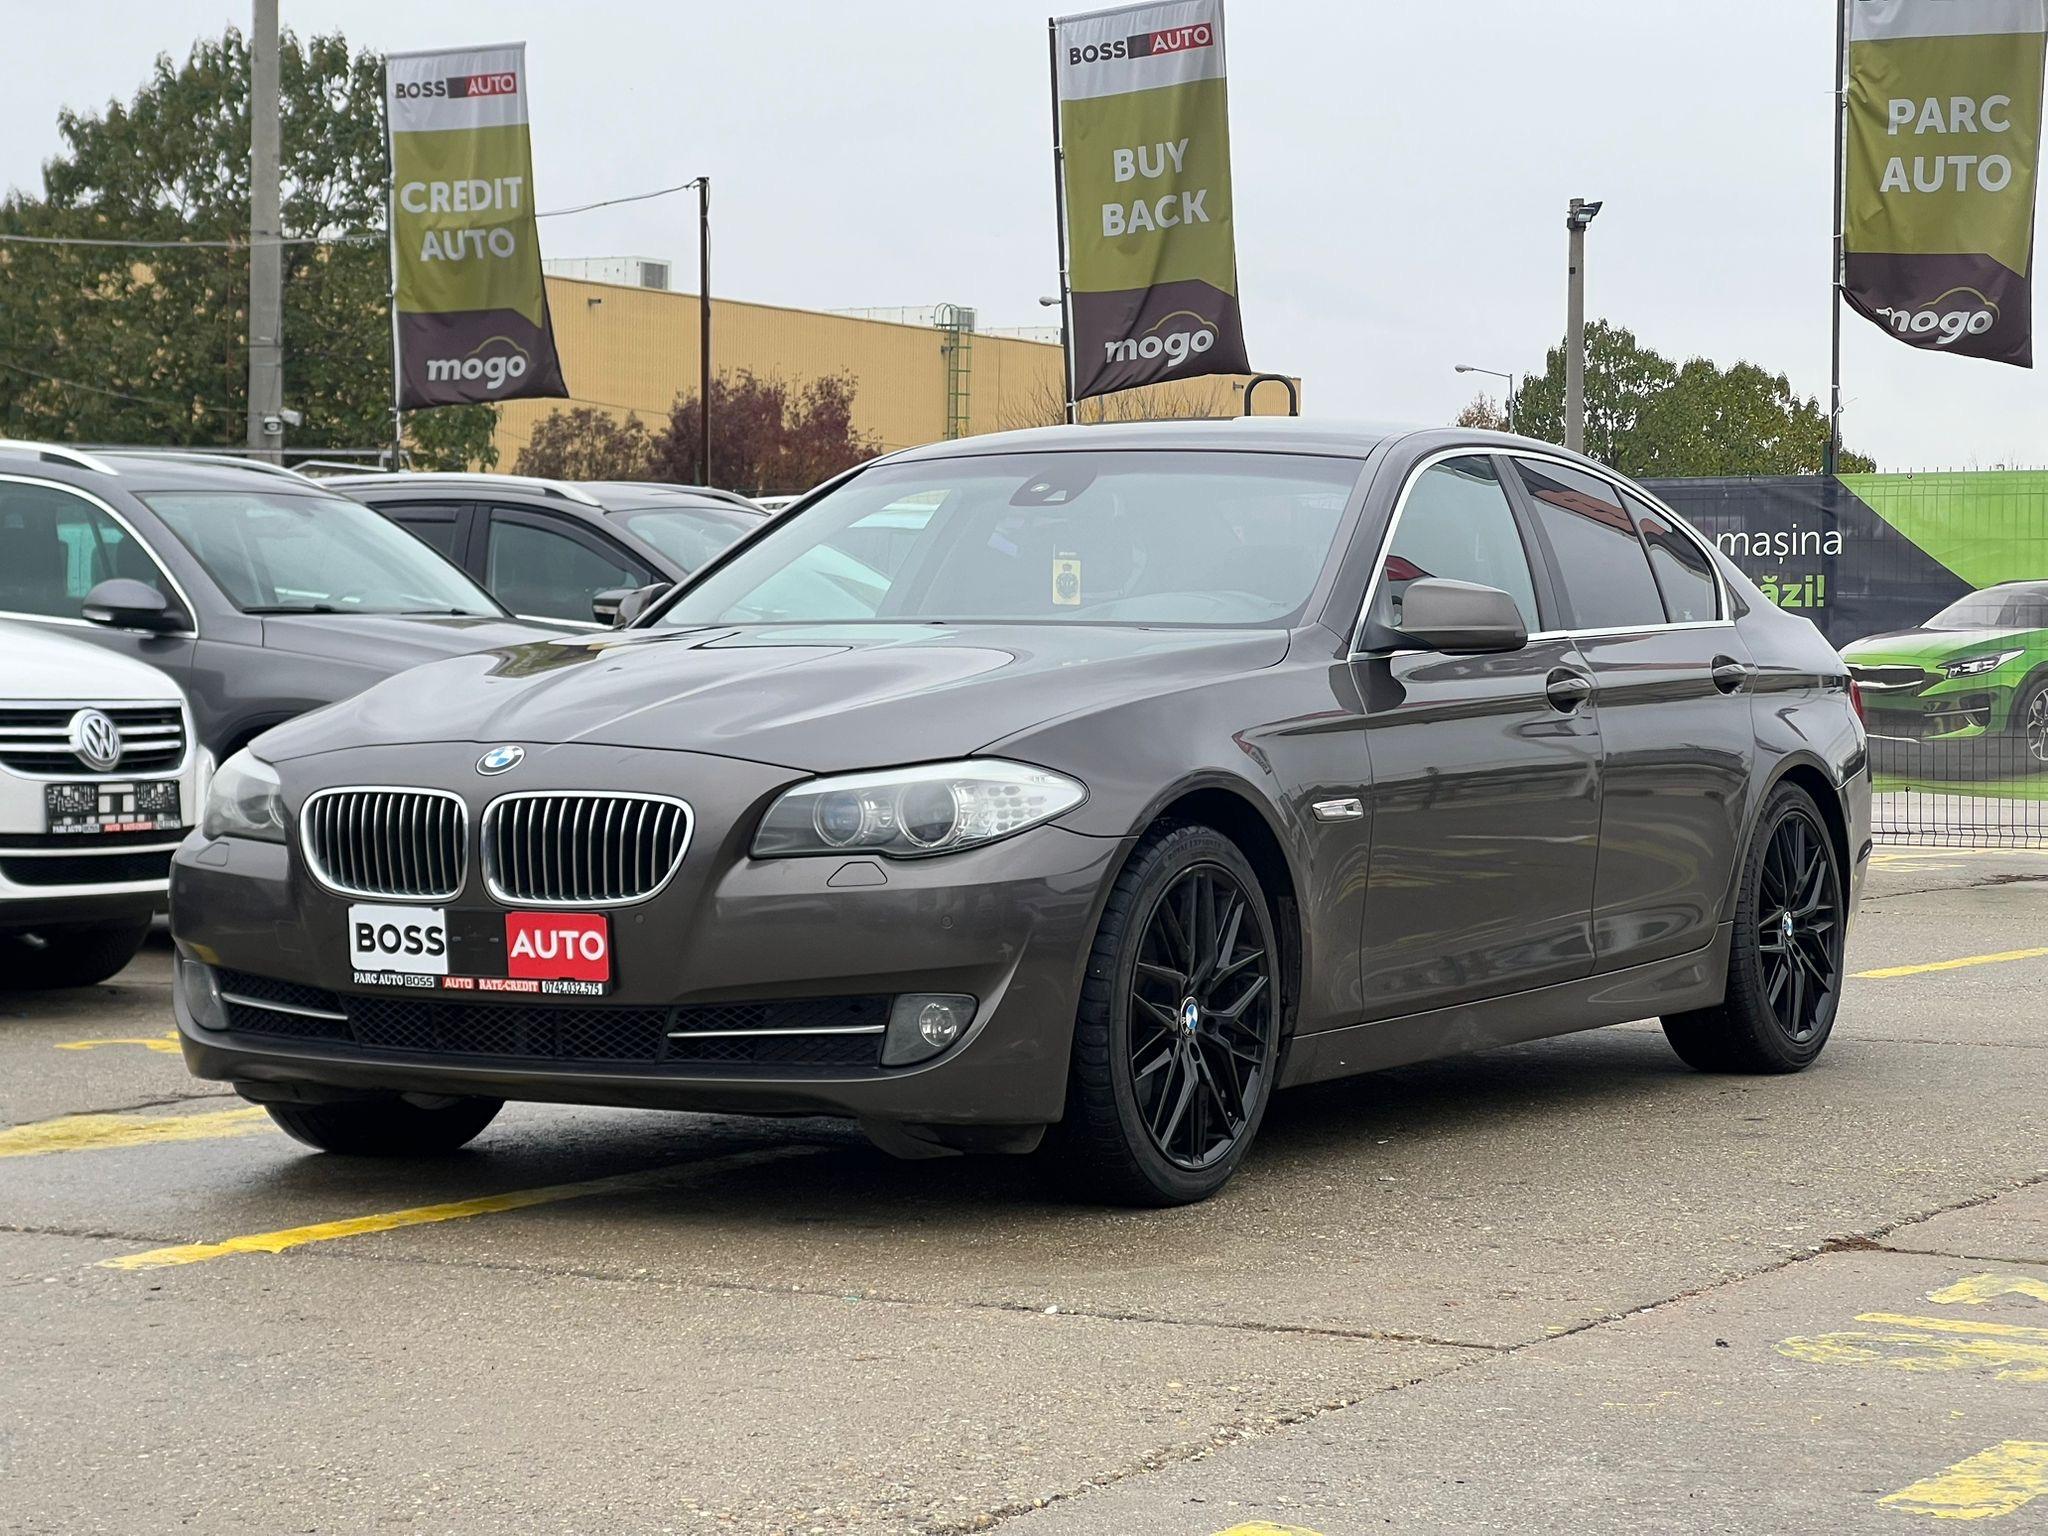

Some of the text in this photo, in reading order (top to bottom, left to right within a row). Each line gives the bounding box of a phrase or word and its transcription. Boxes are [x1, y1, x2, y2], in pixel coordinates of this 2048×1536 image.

[1069, 25, 1210, 65] BOSS AUTO
[395, 74, 515, 99] BOSS AUTO
[1887, 94, 2012, 135] PARC
[1112, 138, 1189, 183] BUY
[1879, 154, 2012, 193] AUTO
[400, 176, 523, 213] CREDIT
[1101, 189, 1210, 237] BACK
[419, 227, 516, 262] AUTO
[1104, 328, 1215, 367] mogo
[426, 354, 527, 389] mogo
[1716, 523, 1843, 564] mașina
[1749, 574, 1825, 607] ăzi!
[355, 922, 605, 961] BOSS AUTO
[353, 972, 378, 984] PARC
[379, 973, 403, 986] AUTO
[406, 975, 433, 987] BOSS
[444, 977, 472, 989] AUTO
[479, 978, 539, 992] RATE-CREDIT
